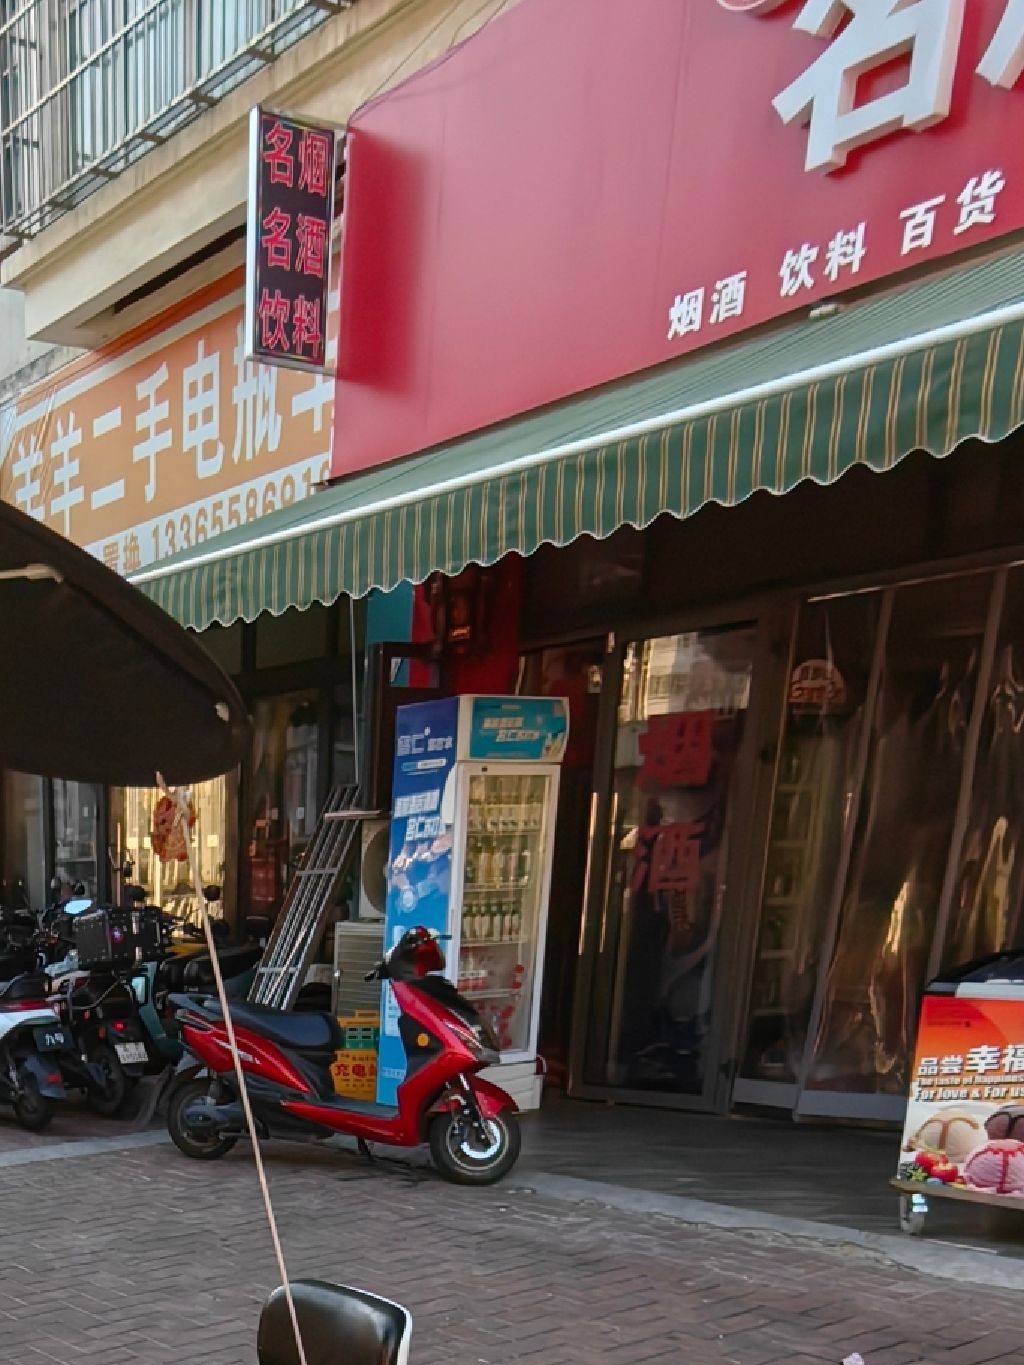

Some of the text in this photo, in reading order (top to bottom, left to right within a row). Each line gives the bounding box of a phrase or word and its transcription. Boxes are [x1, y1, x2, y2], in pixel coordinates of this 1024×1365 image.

[772, 0, 1024, 172] 名
[263, 121, 329, 197] 名烟
[262, 207, 326, 278] 名酒
[667, 168, 1006, 339] 烟酒 饮料 百货
[259, 287, 321, 358] 饮料
